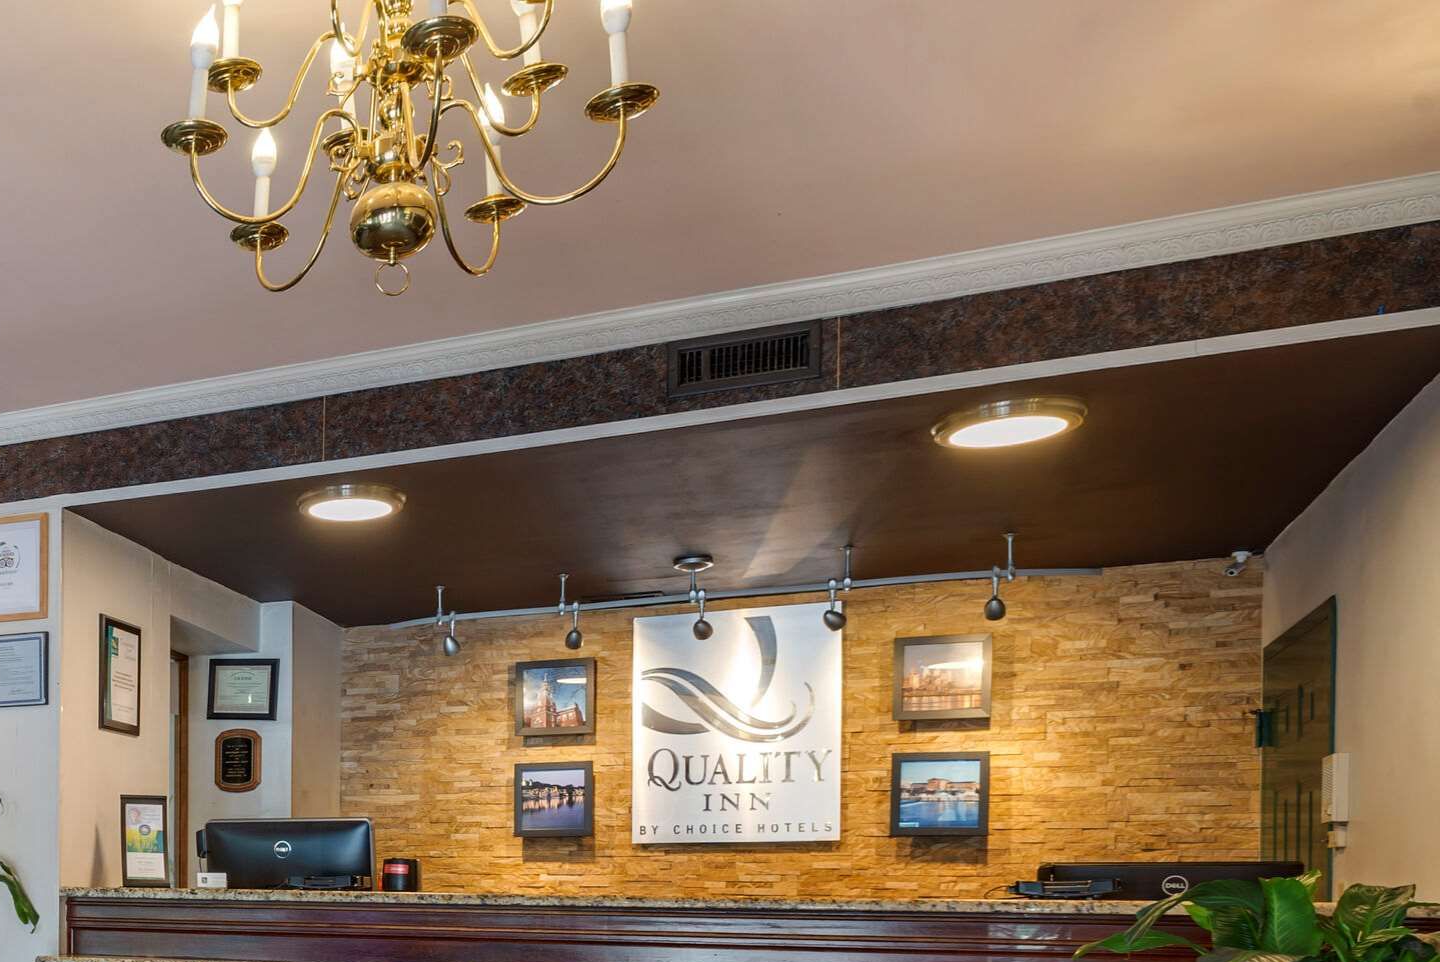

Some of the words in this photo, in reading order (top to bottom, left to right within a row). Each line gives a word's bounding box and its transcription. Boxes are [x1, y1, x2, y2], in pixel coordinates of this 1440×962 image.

[648, 748, 833, 791] QUALITY
[702, 792, 772, 811] INN
[640, 825, 658, 835] BY
[673, 824, 743, 835] CHOICE
[757, 822, 833, 833] HOTELS
